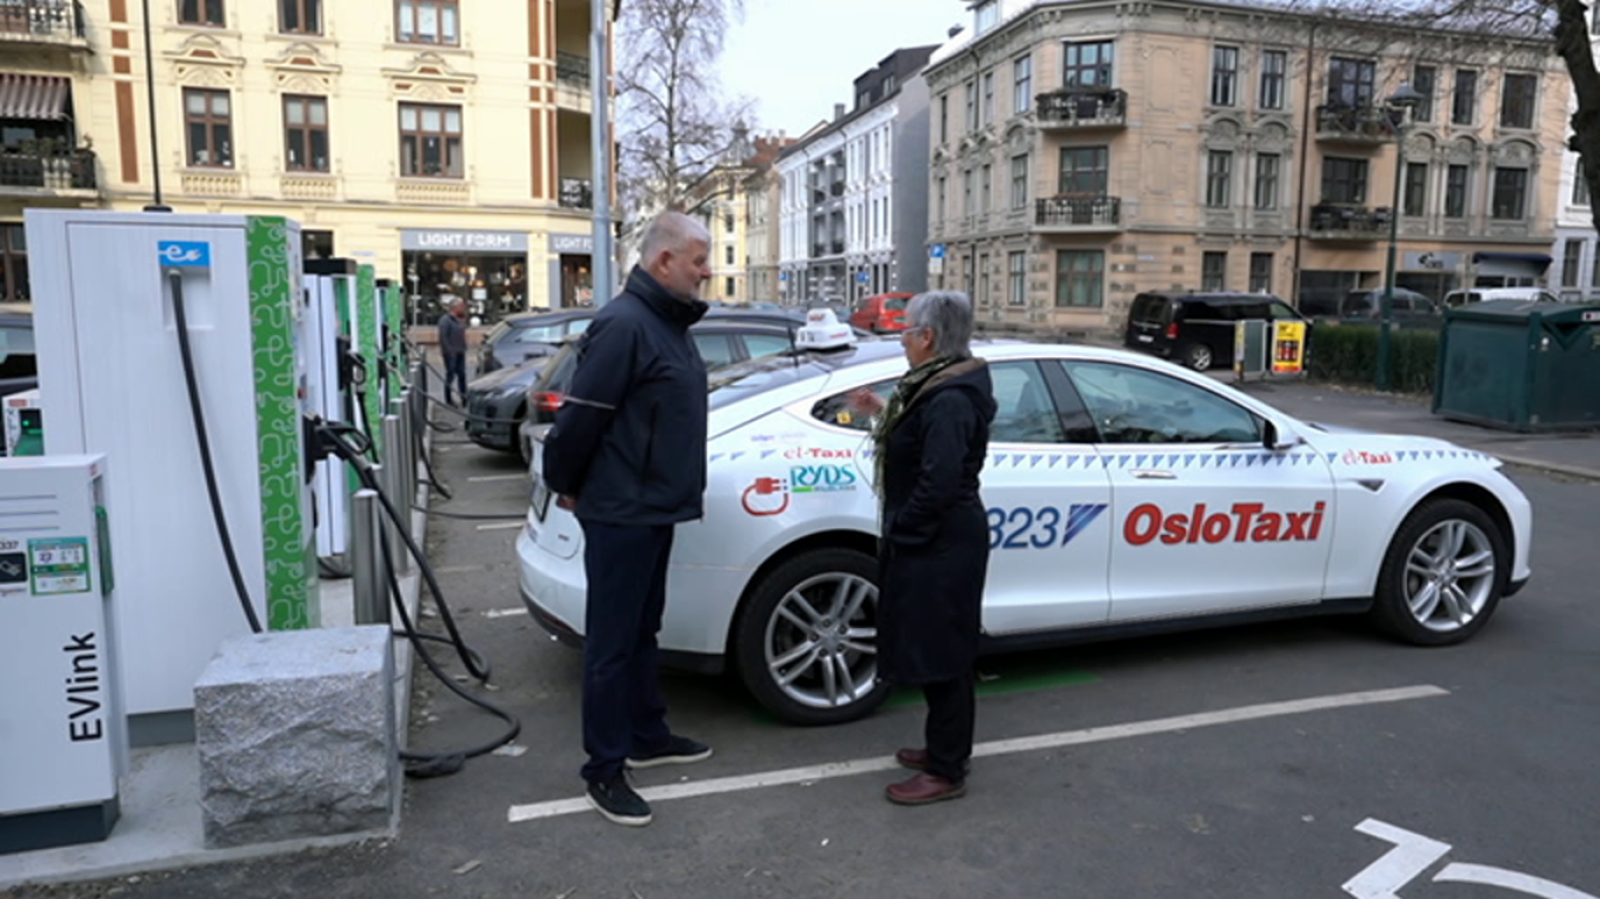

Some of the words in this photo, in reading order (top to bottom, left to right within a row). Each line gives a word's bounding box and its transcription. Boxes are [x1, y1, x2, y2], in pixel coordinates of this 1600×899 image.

[418, 232, 463, 247] LIGHT
[466, 234, 511, 248] FORM
[790, 464, 857, 487] RYDS
[1123, 501, 1326, 546] OsloTaxi
[63, 632, 102, 742] EVlink
